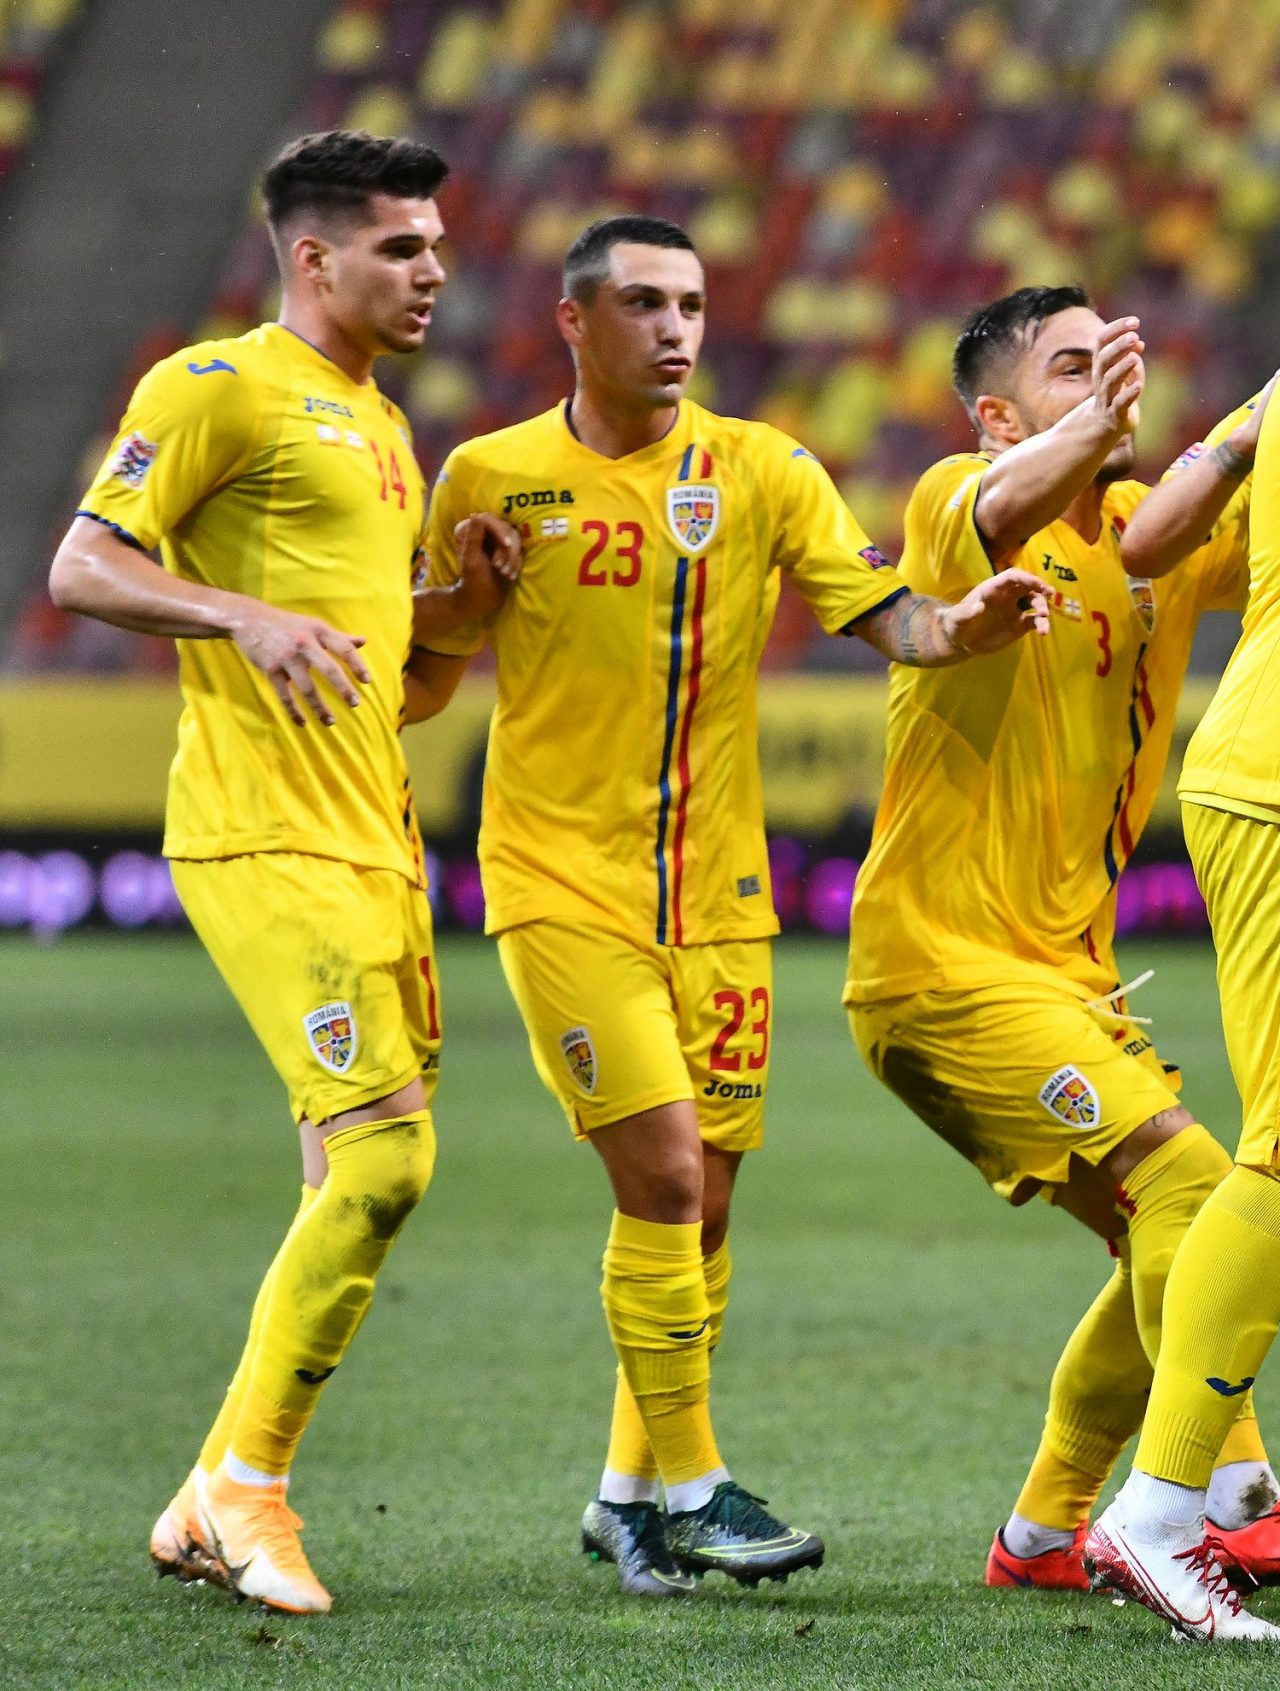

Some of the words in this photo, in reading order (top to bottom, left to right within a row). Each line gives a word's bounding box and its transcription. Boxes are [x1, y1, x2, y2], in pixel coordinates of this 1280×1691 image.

[369, 438, 407, 510] 14
[577, 520, 644, 587] 23
[1091, 610, 1112, 677] 3
[709, 987, 769, 1072] 23
